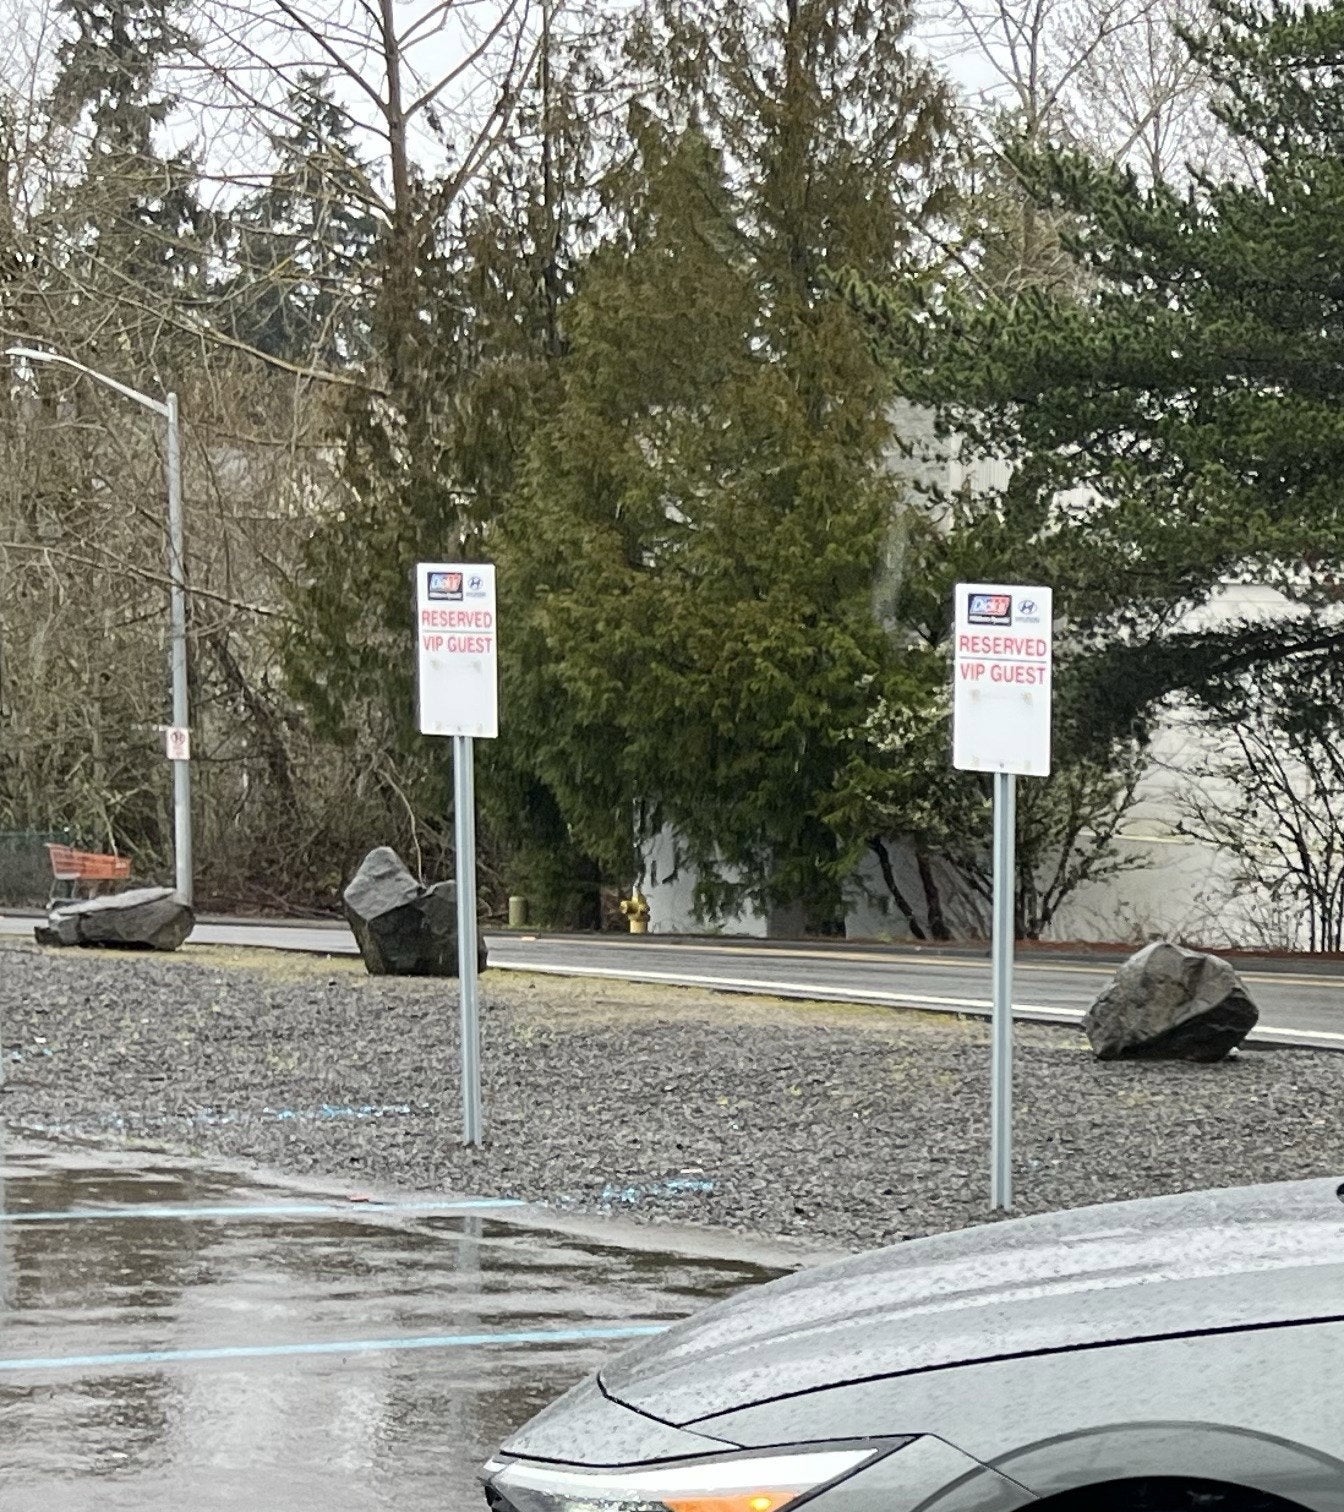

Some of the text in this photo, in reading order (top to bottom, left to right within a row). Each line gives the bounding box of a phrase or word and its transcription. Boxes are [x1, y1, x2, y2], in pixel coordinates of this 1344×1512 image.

[422, 610, 493, 628] RESERVED
[422, 635, 493, 653] VIP GUEST
[959, 635, 1047, 657] RESERVED
[960, 663, 1046, 684] VIP GUEST
